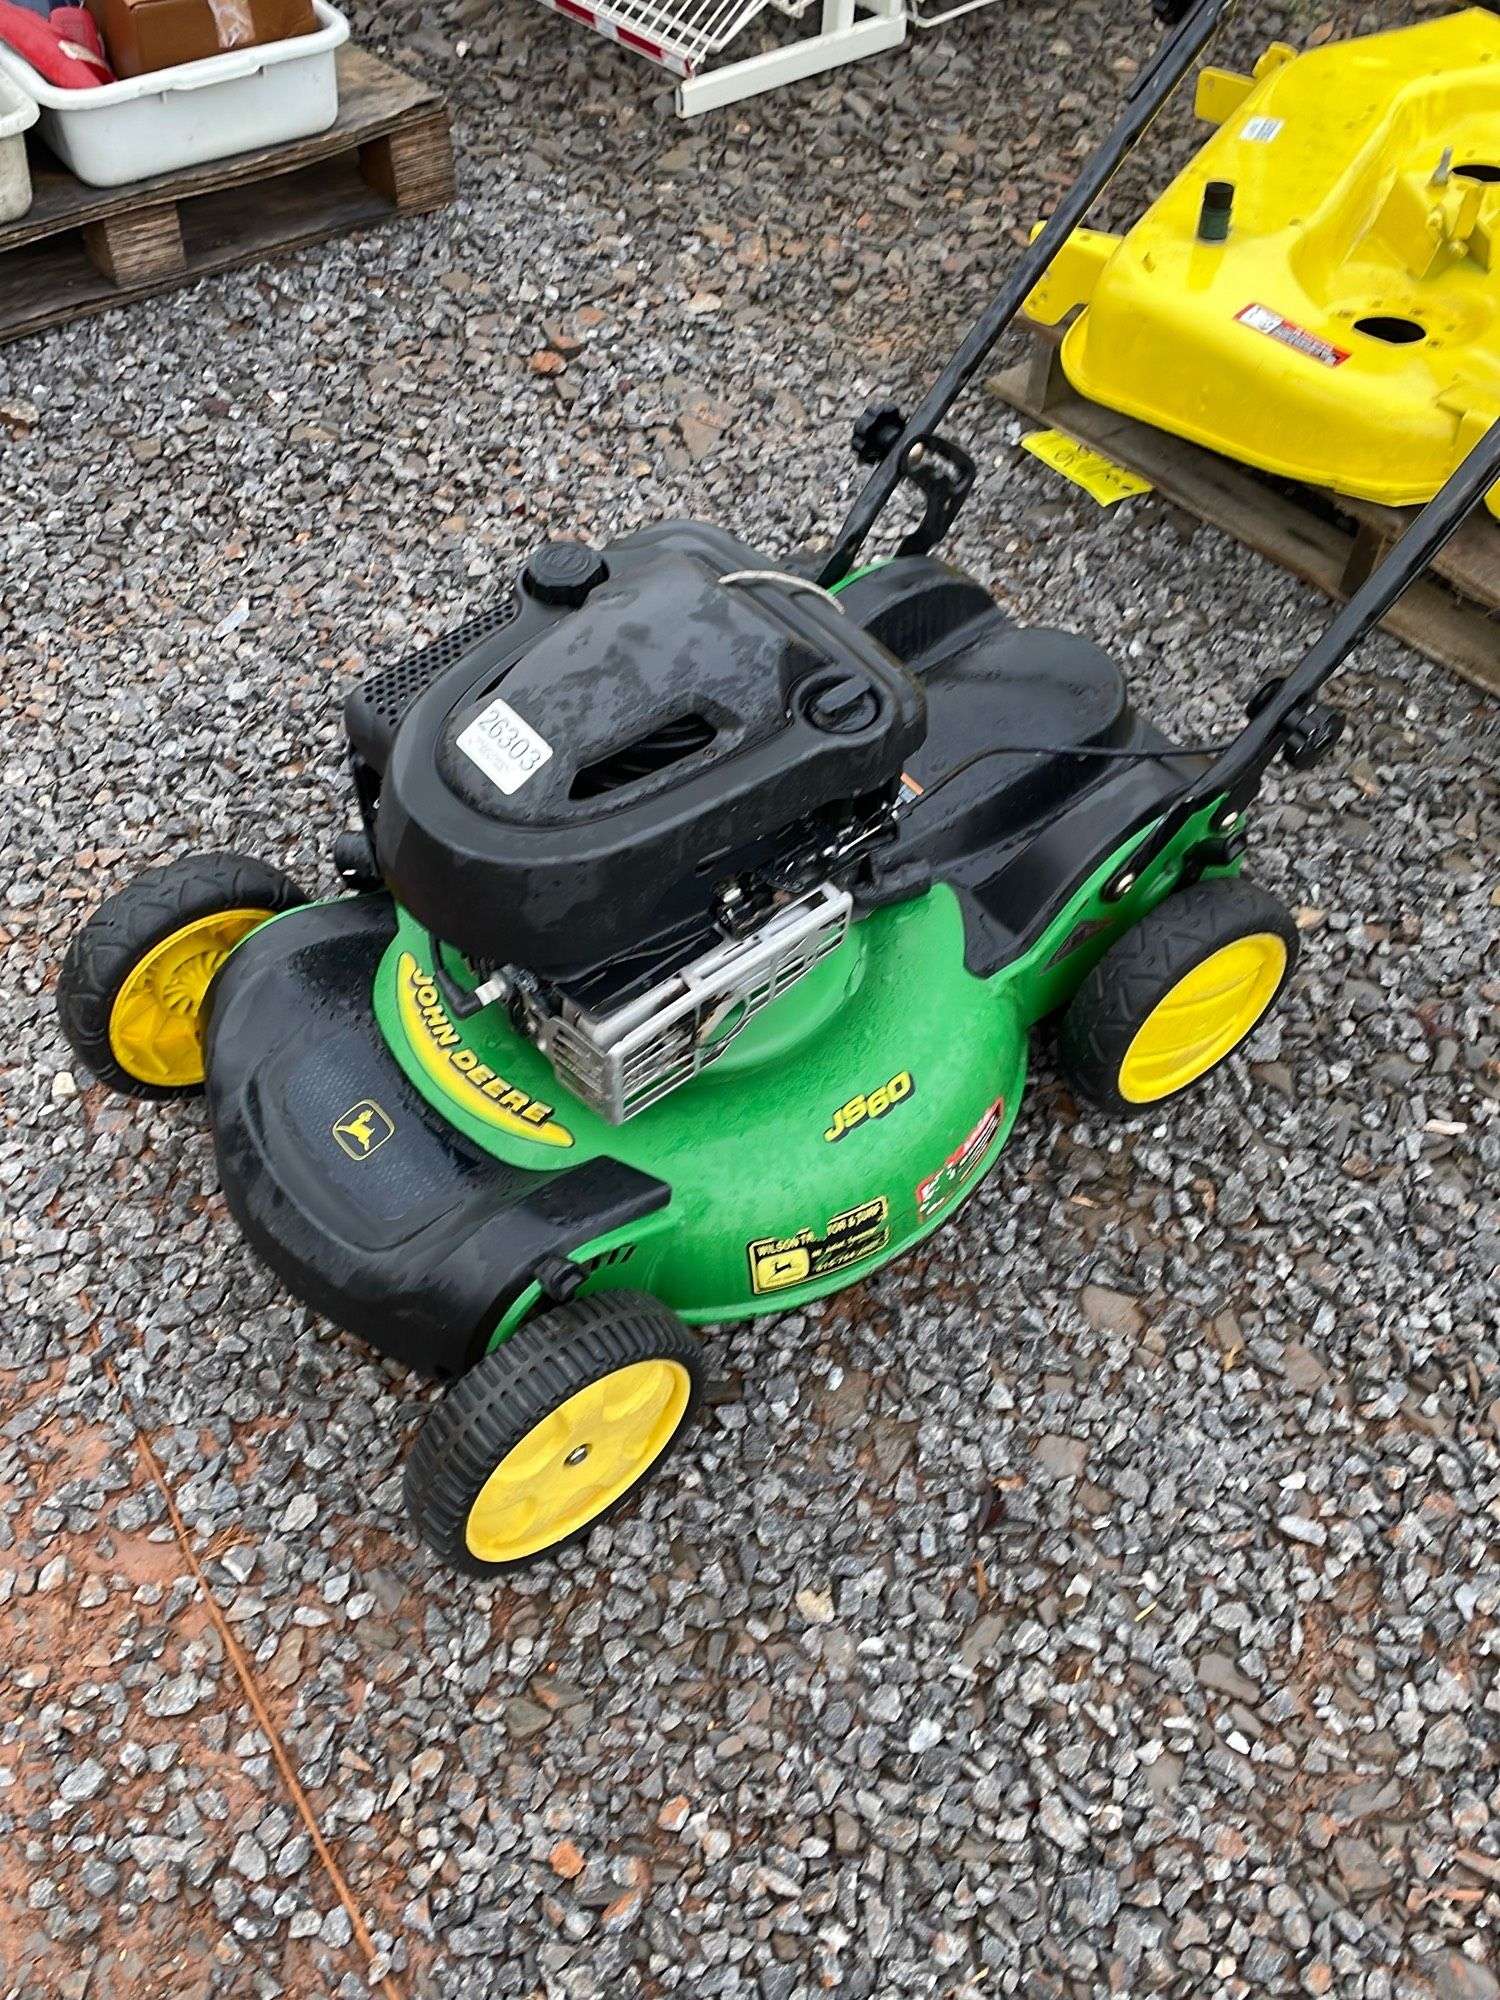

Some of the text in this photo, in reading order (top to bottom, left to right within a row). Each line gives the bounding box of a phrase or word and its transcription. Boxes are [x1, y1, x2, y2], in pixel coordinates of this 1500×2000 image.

[478, 709, 541, 771] 26303
[411, 968, 554, 1126] JOHN DEERE
[824, 1071, 914, 1142] JS60
